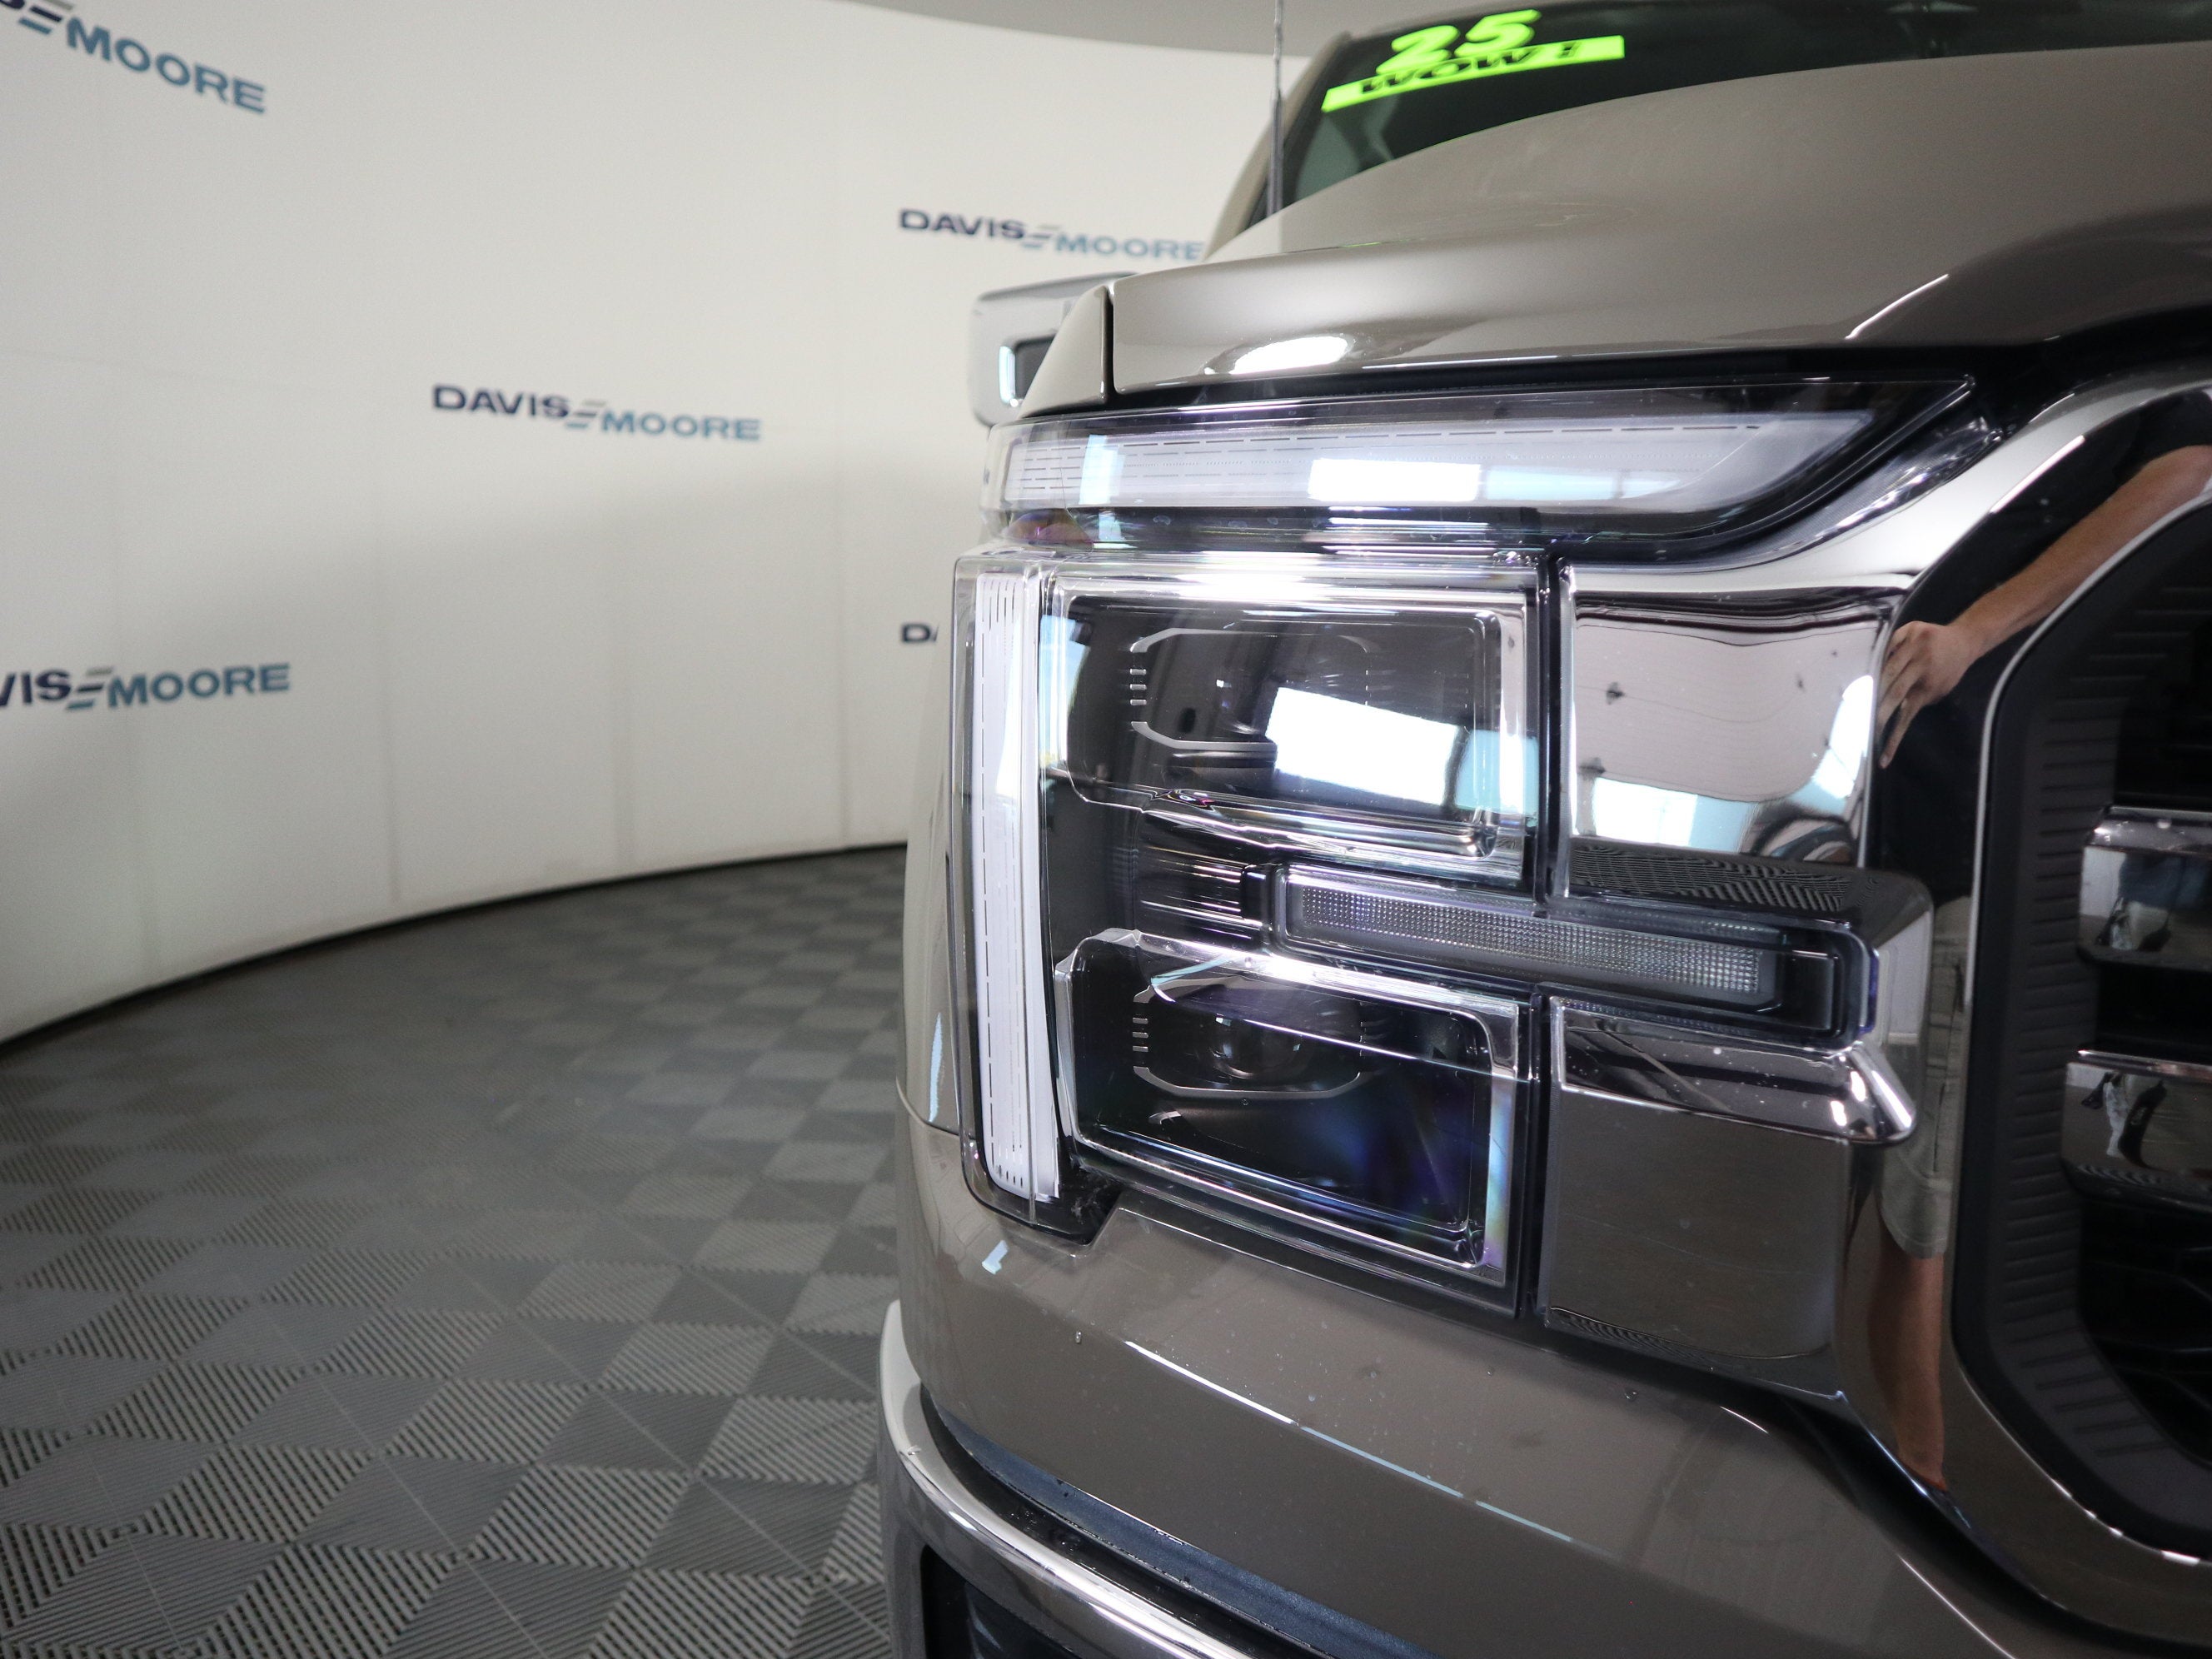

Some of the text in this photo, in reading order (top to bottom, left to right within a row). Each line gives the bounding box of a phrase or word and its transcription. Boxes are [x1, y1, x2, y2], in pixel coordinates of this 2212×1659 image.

[66, 17, 266, 115] MOORE
[1375, 8, 1542, 75] 25
[899, 208, 1204, 262] DAVIS MOORE
[432, 384, 760, 441] DAVIS MOORE
[107, 662, 291, 708] MOORE
